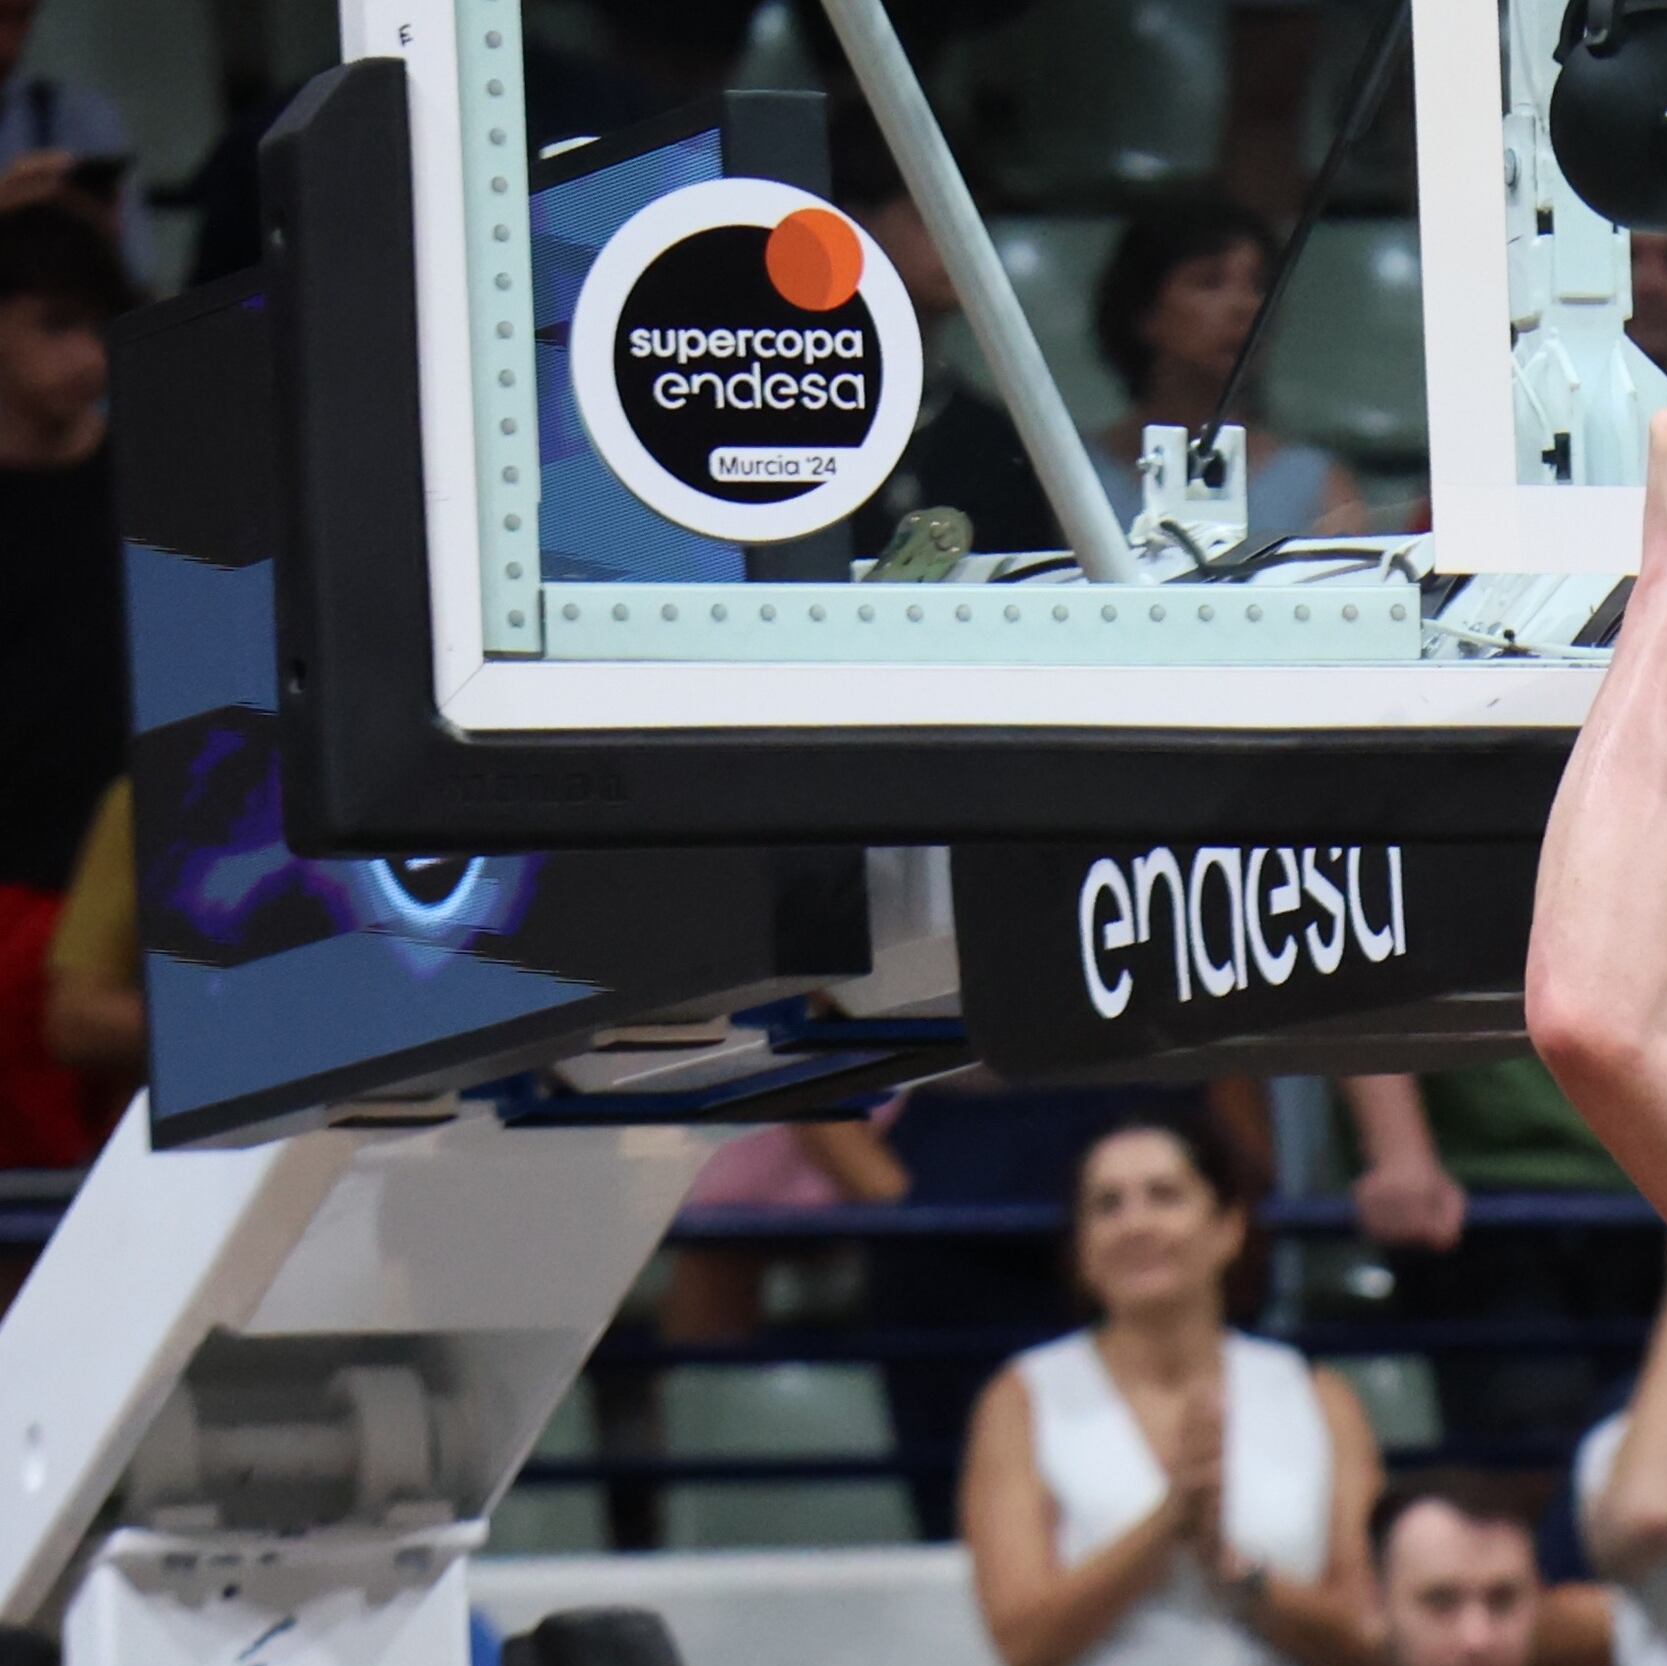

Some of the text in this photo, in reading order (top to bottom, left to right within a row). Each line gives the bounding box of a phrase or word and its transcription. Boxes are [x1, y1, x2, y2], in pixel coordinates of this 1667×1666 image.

[630, 328, 864, 364] supercopa
[653, 362, 866, 409] endesa
[718, 456, 800, 477] Murcia
